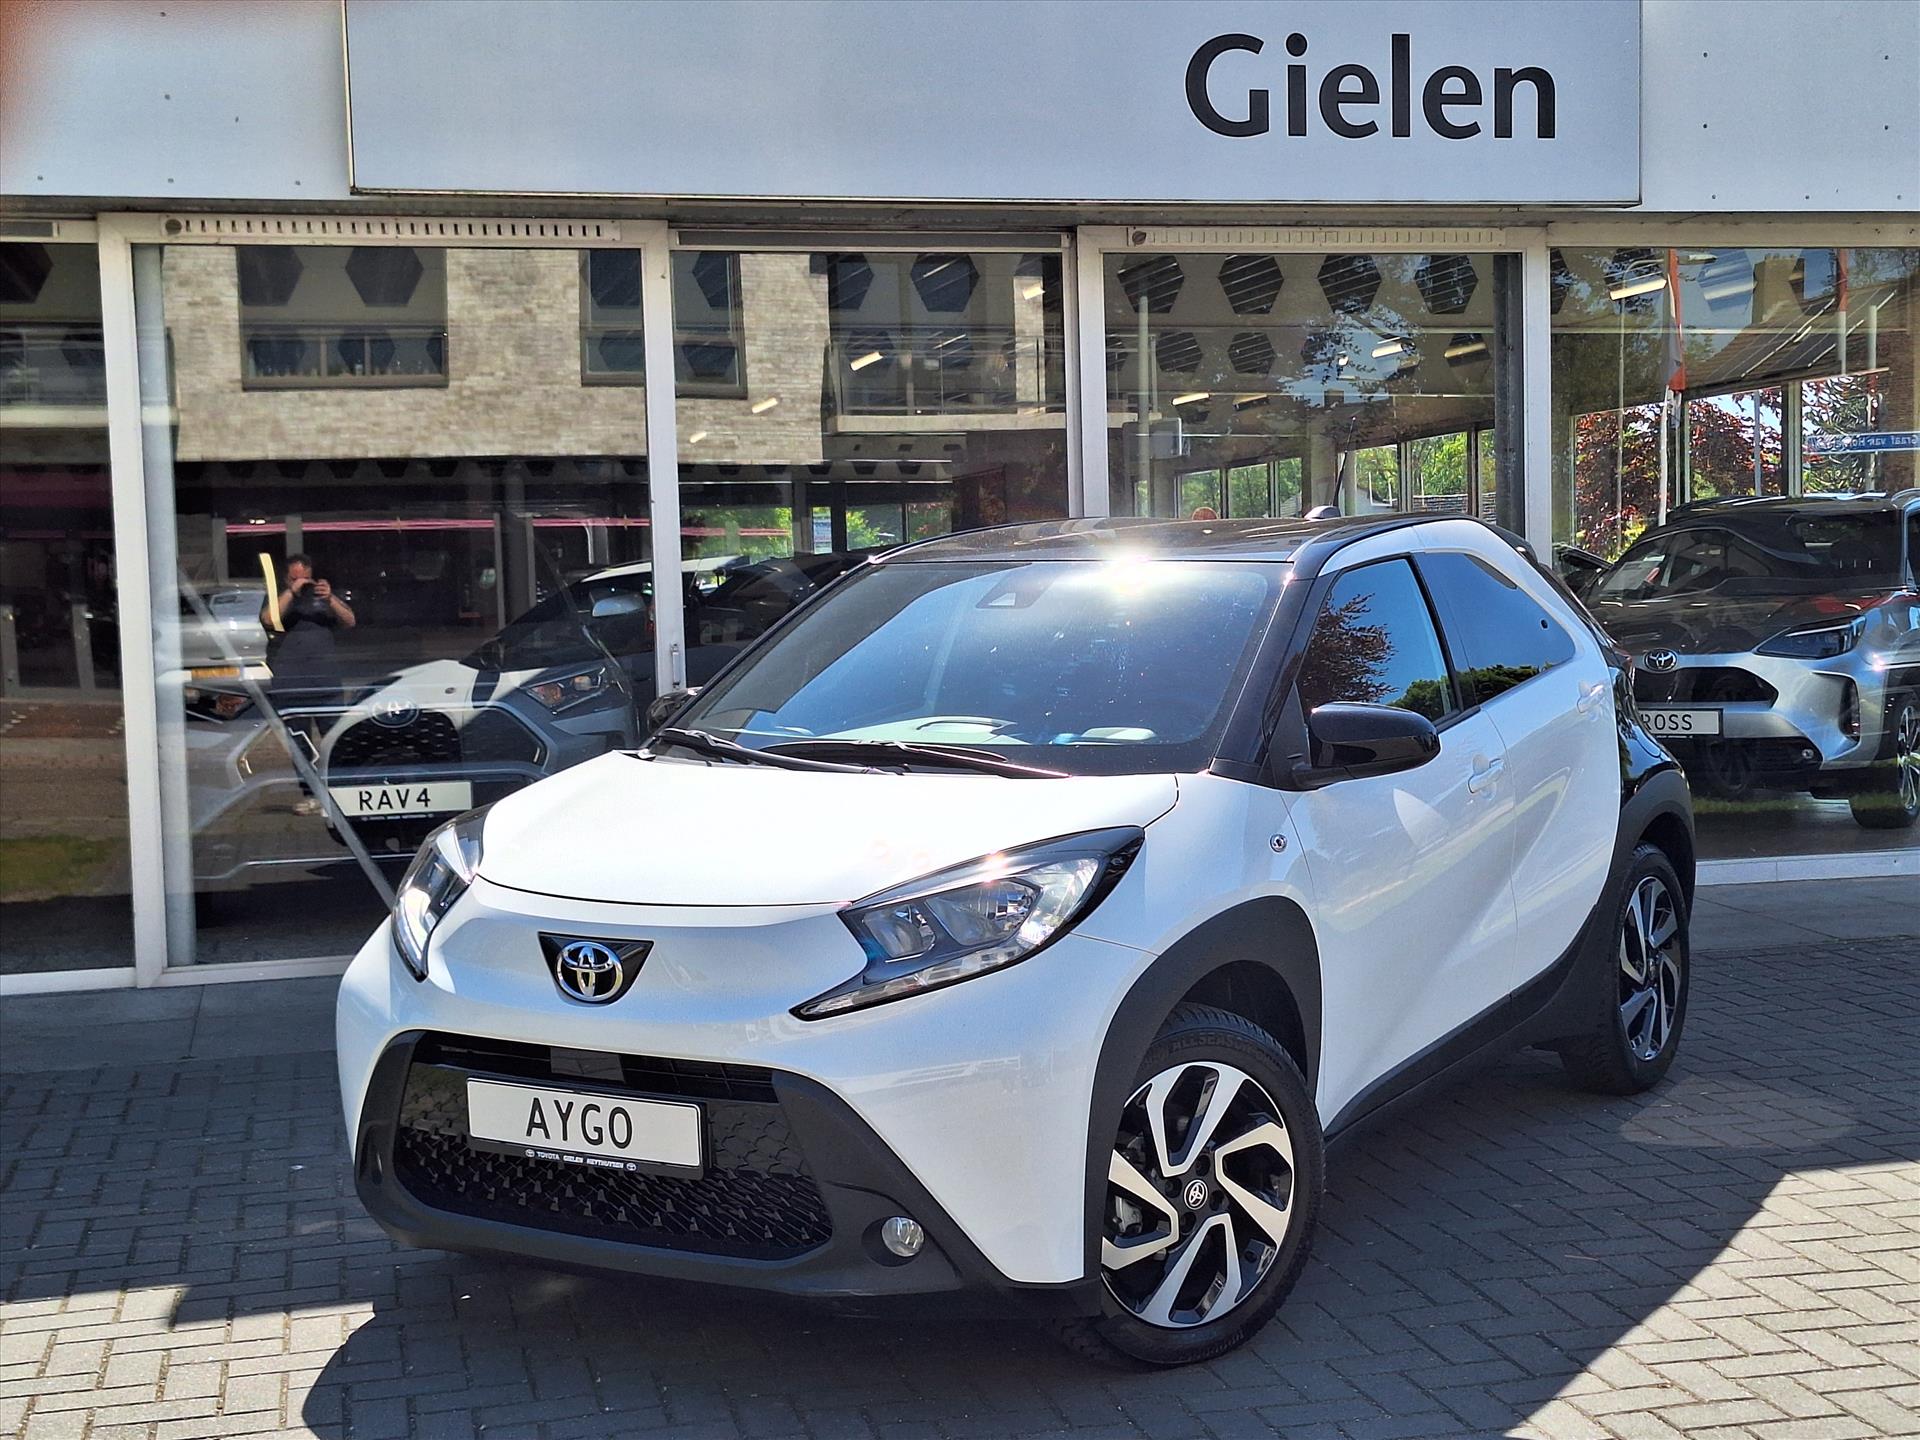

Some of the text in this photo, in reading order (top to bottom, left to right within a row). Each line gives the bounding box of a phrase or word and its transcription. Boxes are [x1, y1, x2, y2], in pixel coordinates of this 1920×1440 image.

[1184, 32, 1556, 140] Gielen
[358, 787, 431, 811] RAV4
[525, 1097, 633, 1149] AYGO
[536, 1151, 560, 1160] TOYOTA
